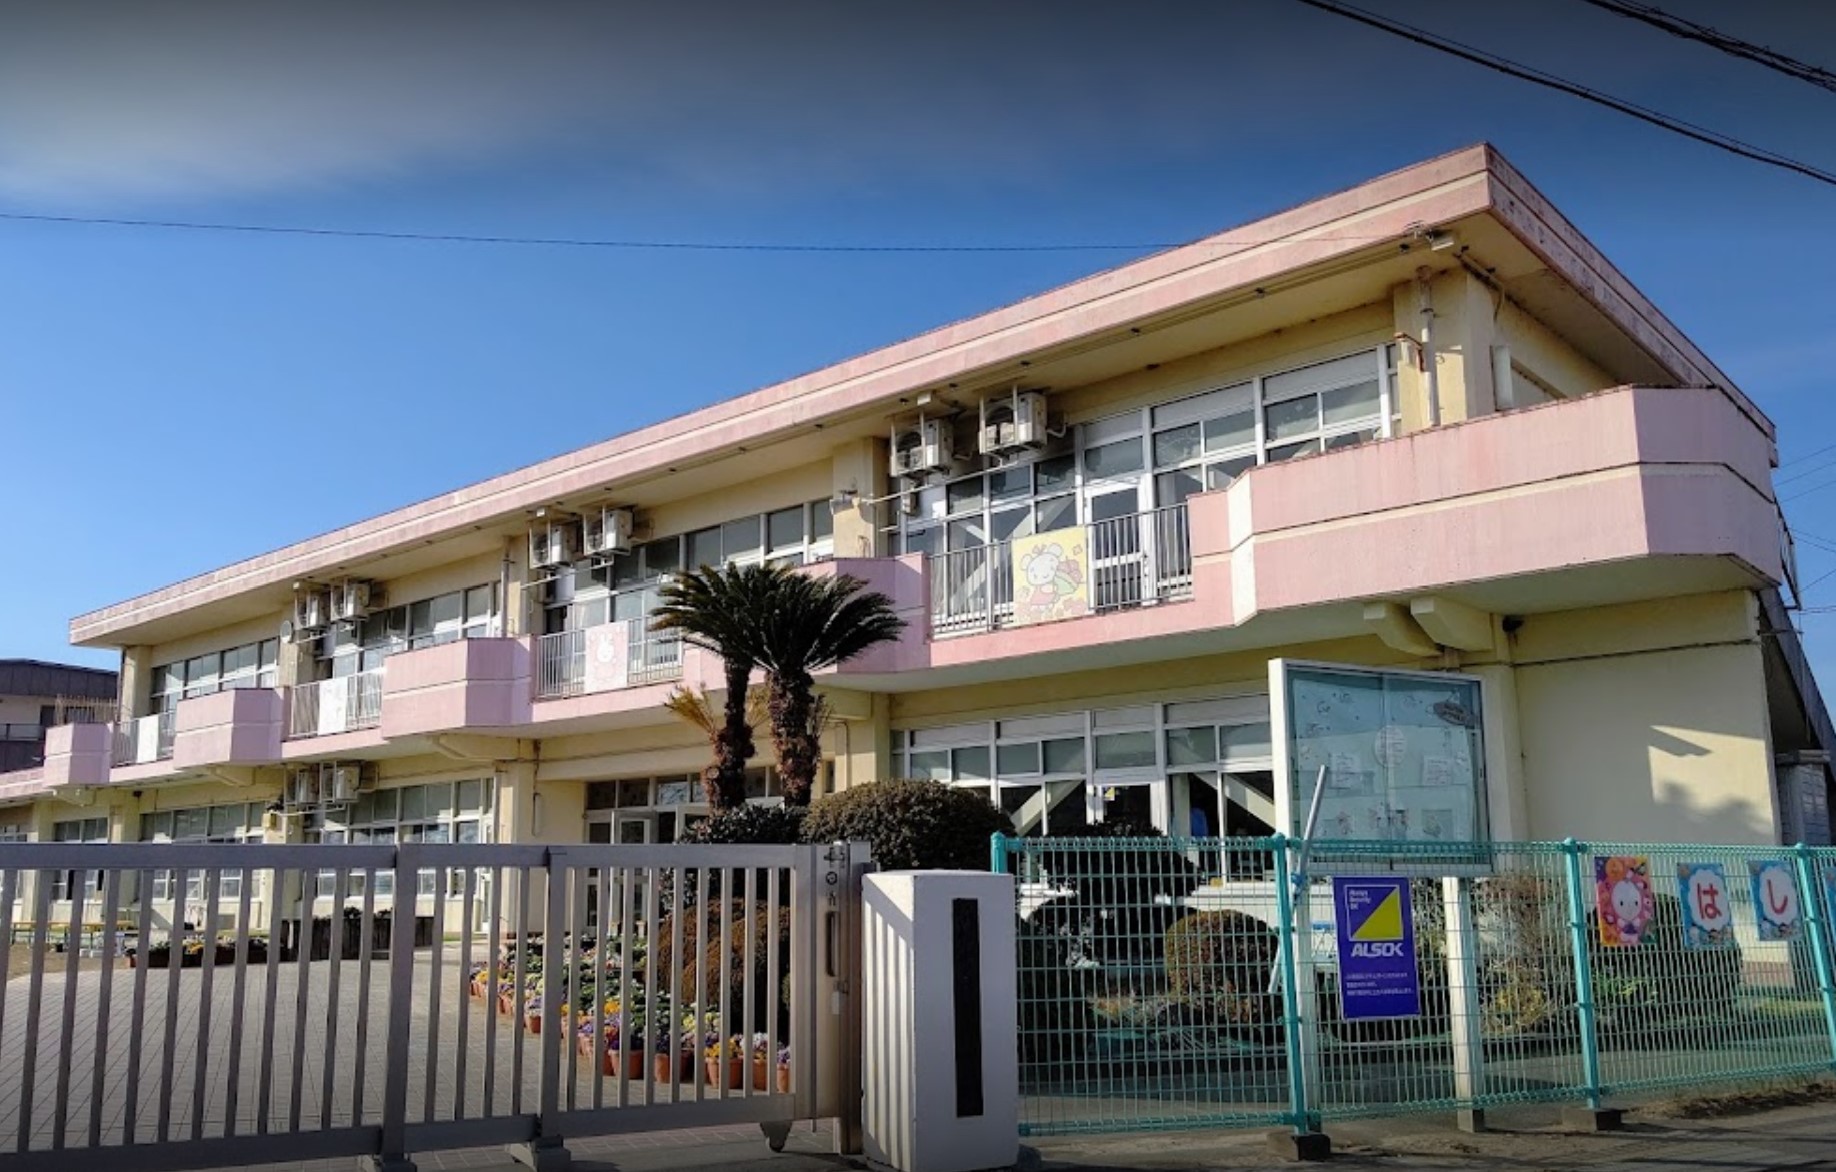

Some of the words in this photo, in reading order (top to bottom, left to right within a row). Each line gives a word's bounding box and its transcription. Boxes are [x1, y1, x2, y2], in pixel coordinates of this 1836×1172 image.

[1697, 882, 1722, 919] は
[1766, 879, 1788, 915] し
[1351, 942, 1404, 957] ALSOK
